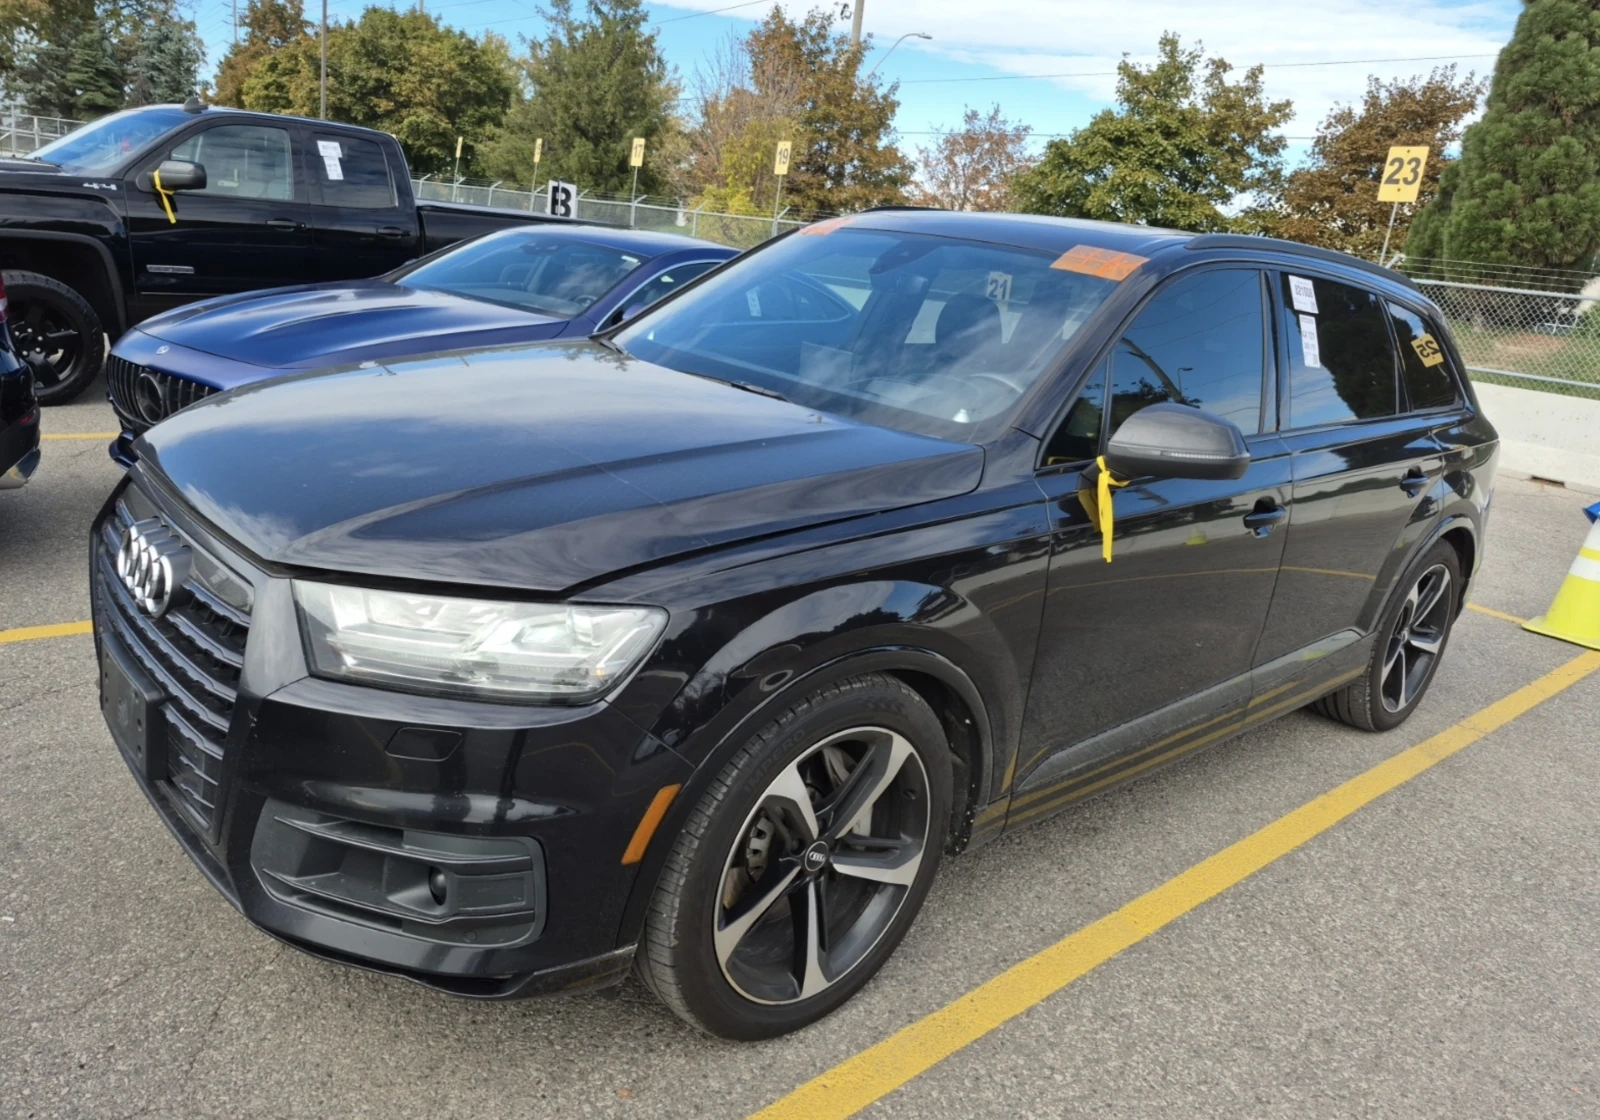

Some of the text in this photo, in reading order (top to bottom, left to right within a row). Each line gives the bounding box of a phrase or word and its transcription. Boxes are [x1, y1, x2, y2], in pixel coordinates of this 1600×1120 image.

[778, 147, 789, 165] 19
[1384, 156, 1421, 186] 23
[551, 186, 572, 218] B
[989, 279, 1008, 300] 21
